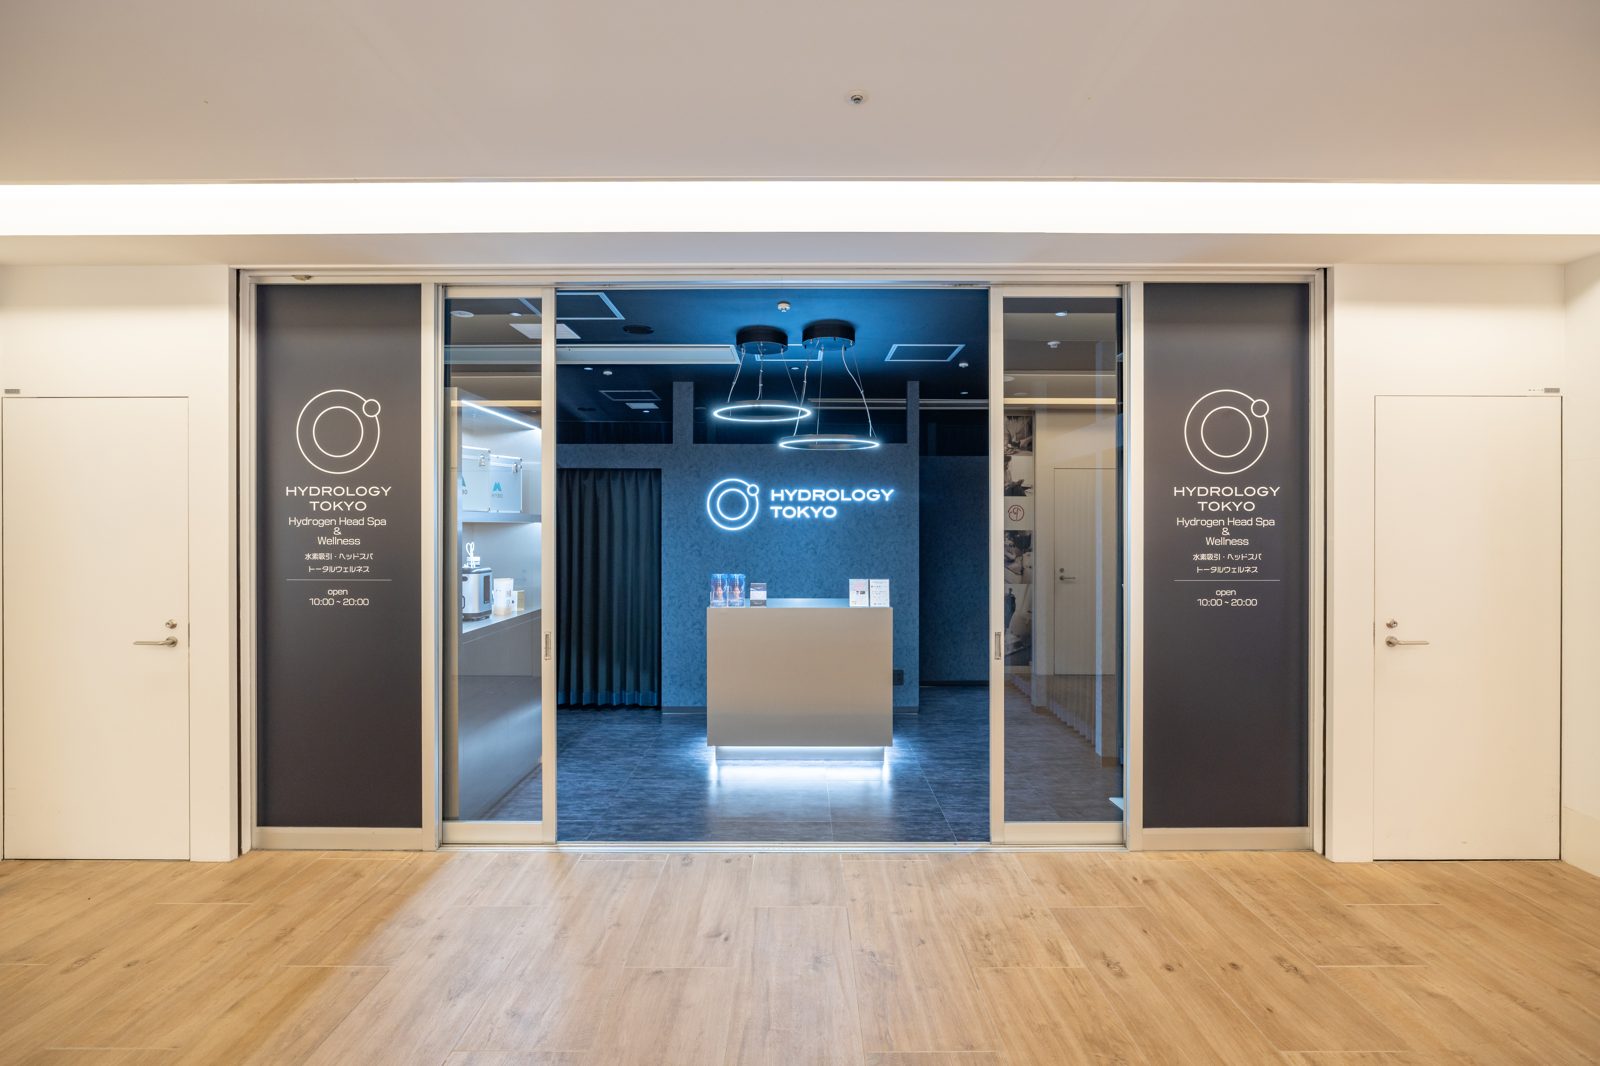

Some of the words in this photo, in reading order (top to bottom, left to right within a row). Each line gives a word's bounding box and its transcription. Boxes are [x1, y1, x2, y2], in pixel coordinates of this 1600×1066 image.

[285, 486, 392, 497] HYDROLOGY
[770, 489, 895, 502] HYDROLOGY
[1173, 486, 1281, 497] HYDROLOGY
[309, 501, 368, 512] TOKYO
[1197, 501, 1256, 512] TOKYO
[770, 506, 838, 519] TOKYO
[288, 517, 337, 528] Hydrogen
[338, 517, 365, 526] Head
[367, 517, 387, 528] Spa
[1176, 517, 1225, 528] Hydrogen
[1227, 517, 1254, 527] Head
[1255, 517, 1276, 528] Spa
[333, 526, 342, 536] &
[1221, 527, 1231, 536] &
[317, 536, 361, 546] Wellness
[1205, 537, 1250, 546] Wellness
[308, 565, 370, 573] トータルウェルネス
[1196, 566, 1259, 574] トータルウェルネス
[327, 589, 349, 597] open
[1215, 590, 1237, 598] open
[309, 598, 335, 606] 10:00
[342, 598, 370, 606] 20:00
[1197, 598, 1223, 607] 10:00
[1230, 598, 1258, 607] 20:00
